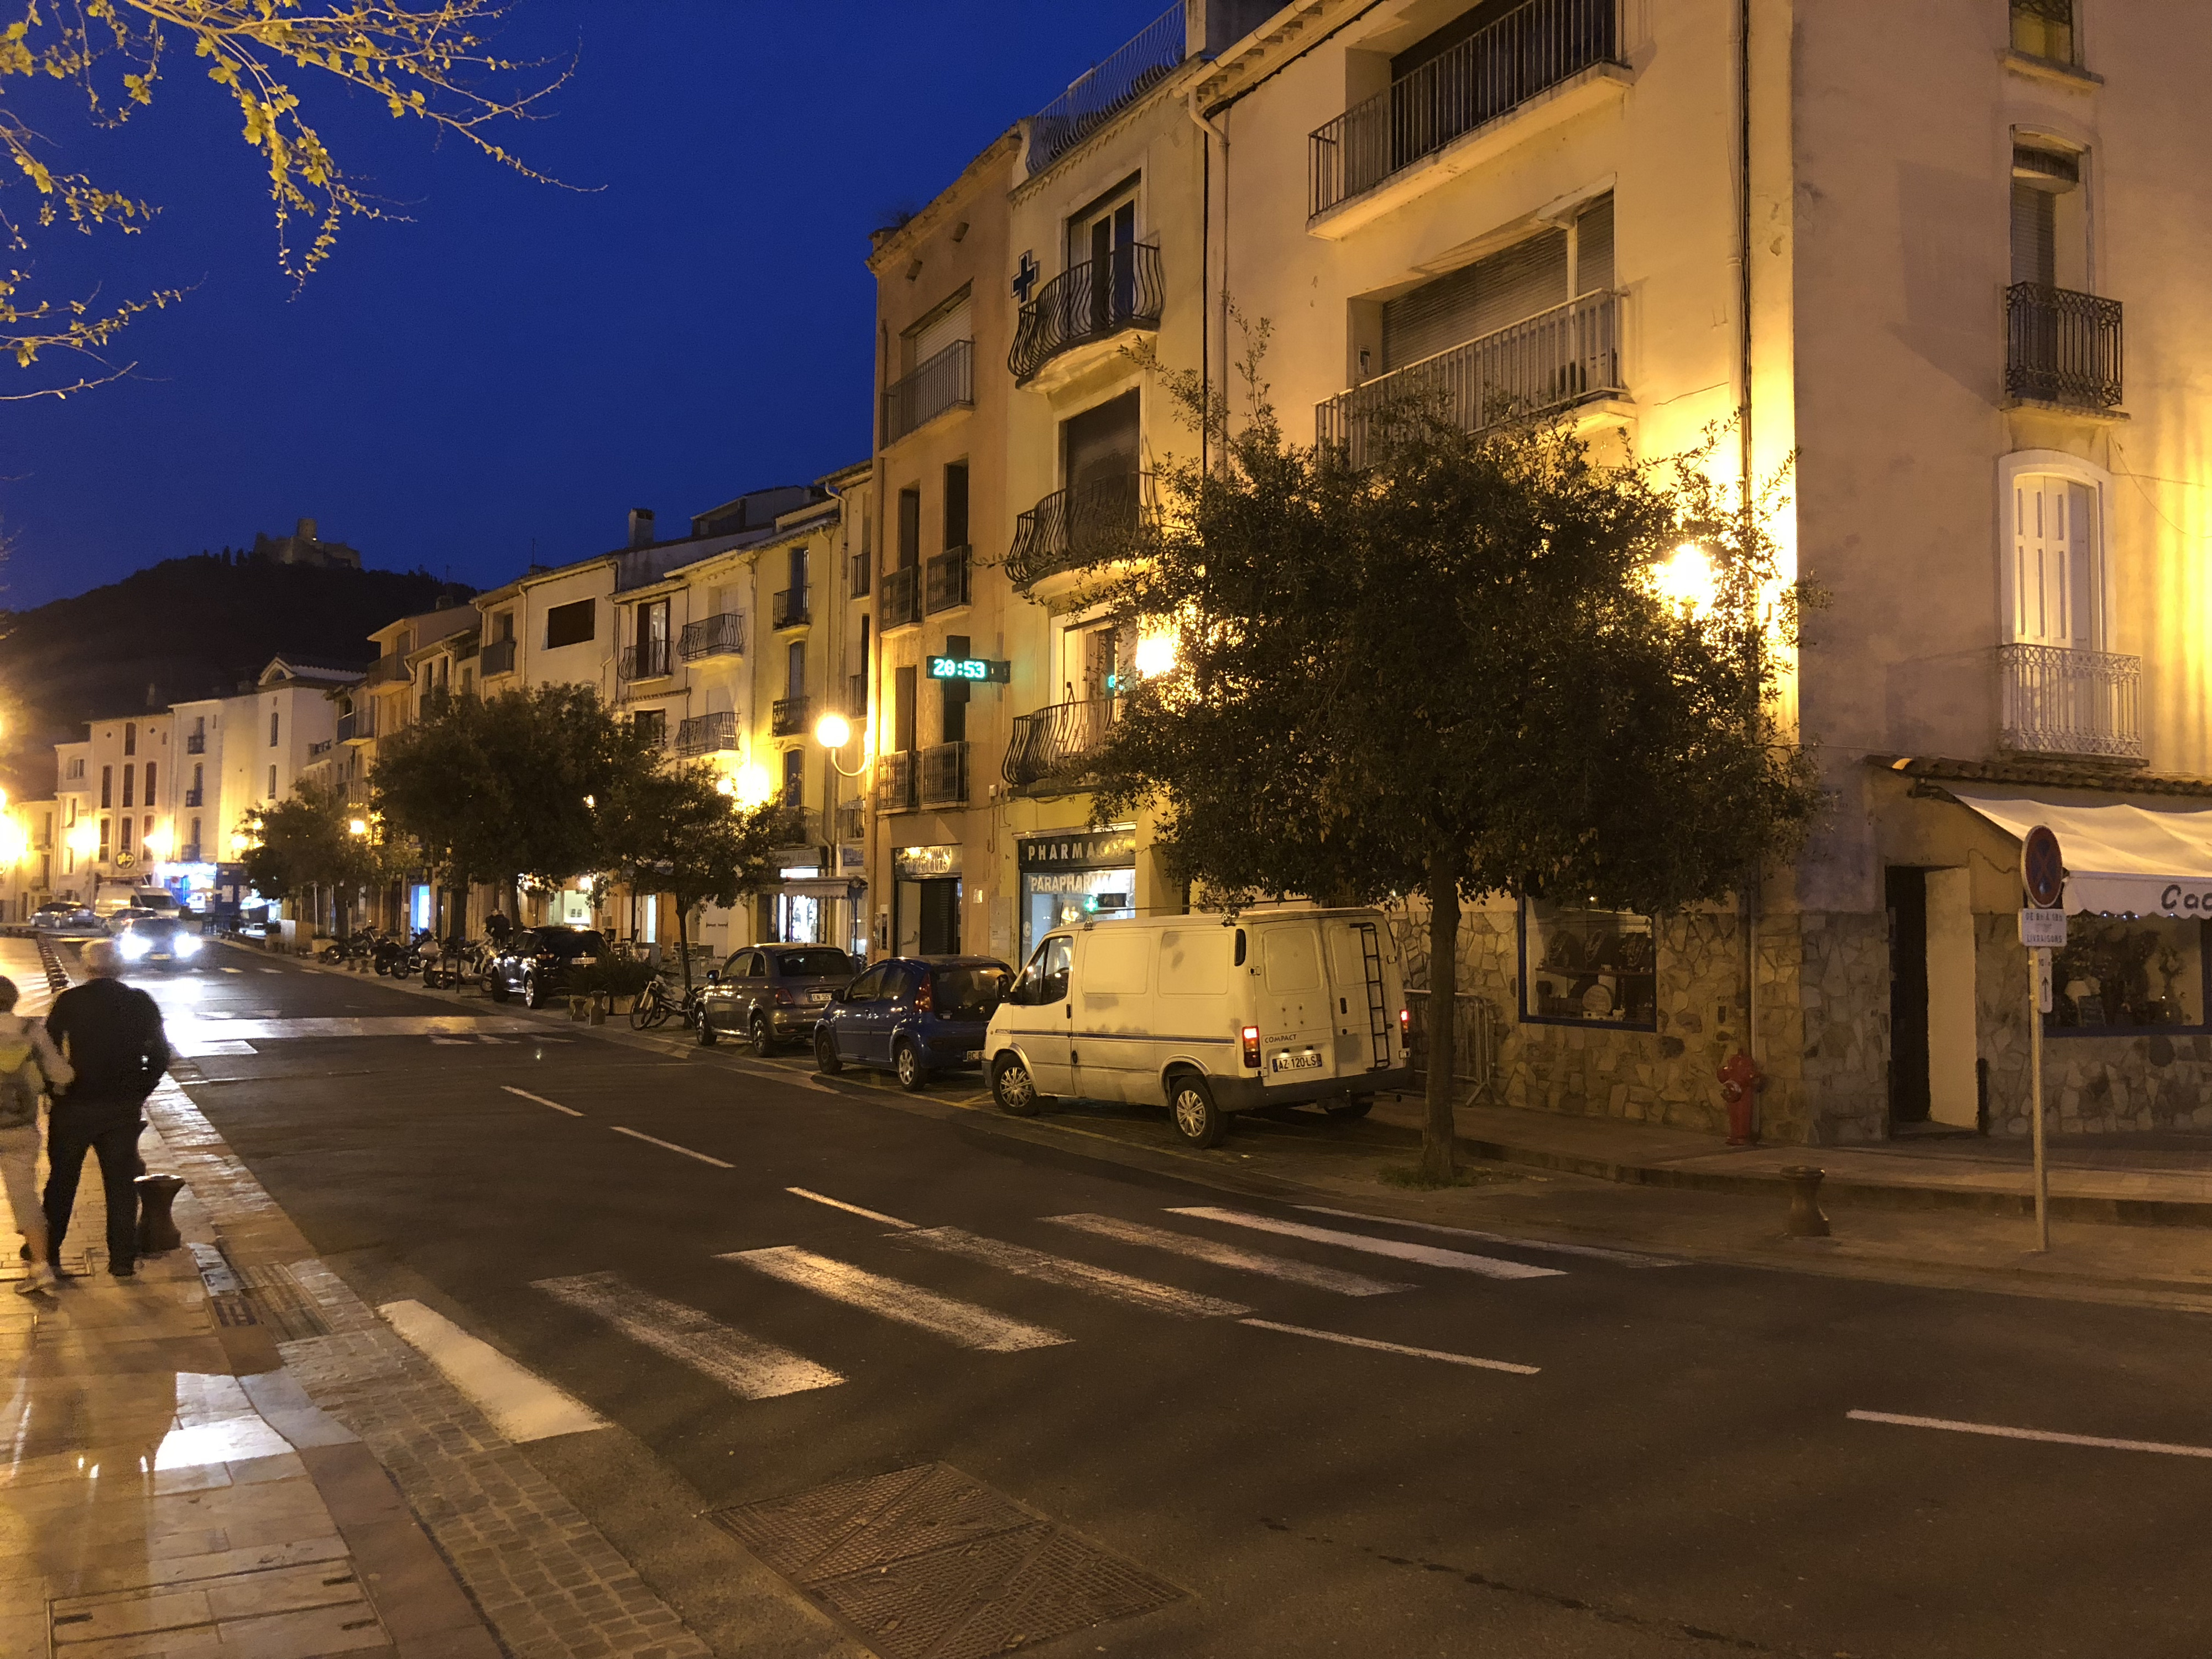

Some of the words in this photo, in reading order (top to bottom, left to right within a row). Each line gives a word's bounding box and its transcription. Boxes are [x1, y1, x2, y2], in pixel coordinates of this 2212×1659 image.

[933, 659, 985, 679] 20:53
[1028, 839, 1126, 861] PHARMACIE
[2027, 935, 2062, 943] LIVRAISONS
[1264, 1034, 1297, 1044] COMPACT
